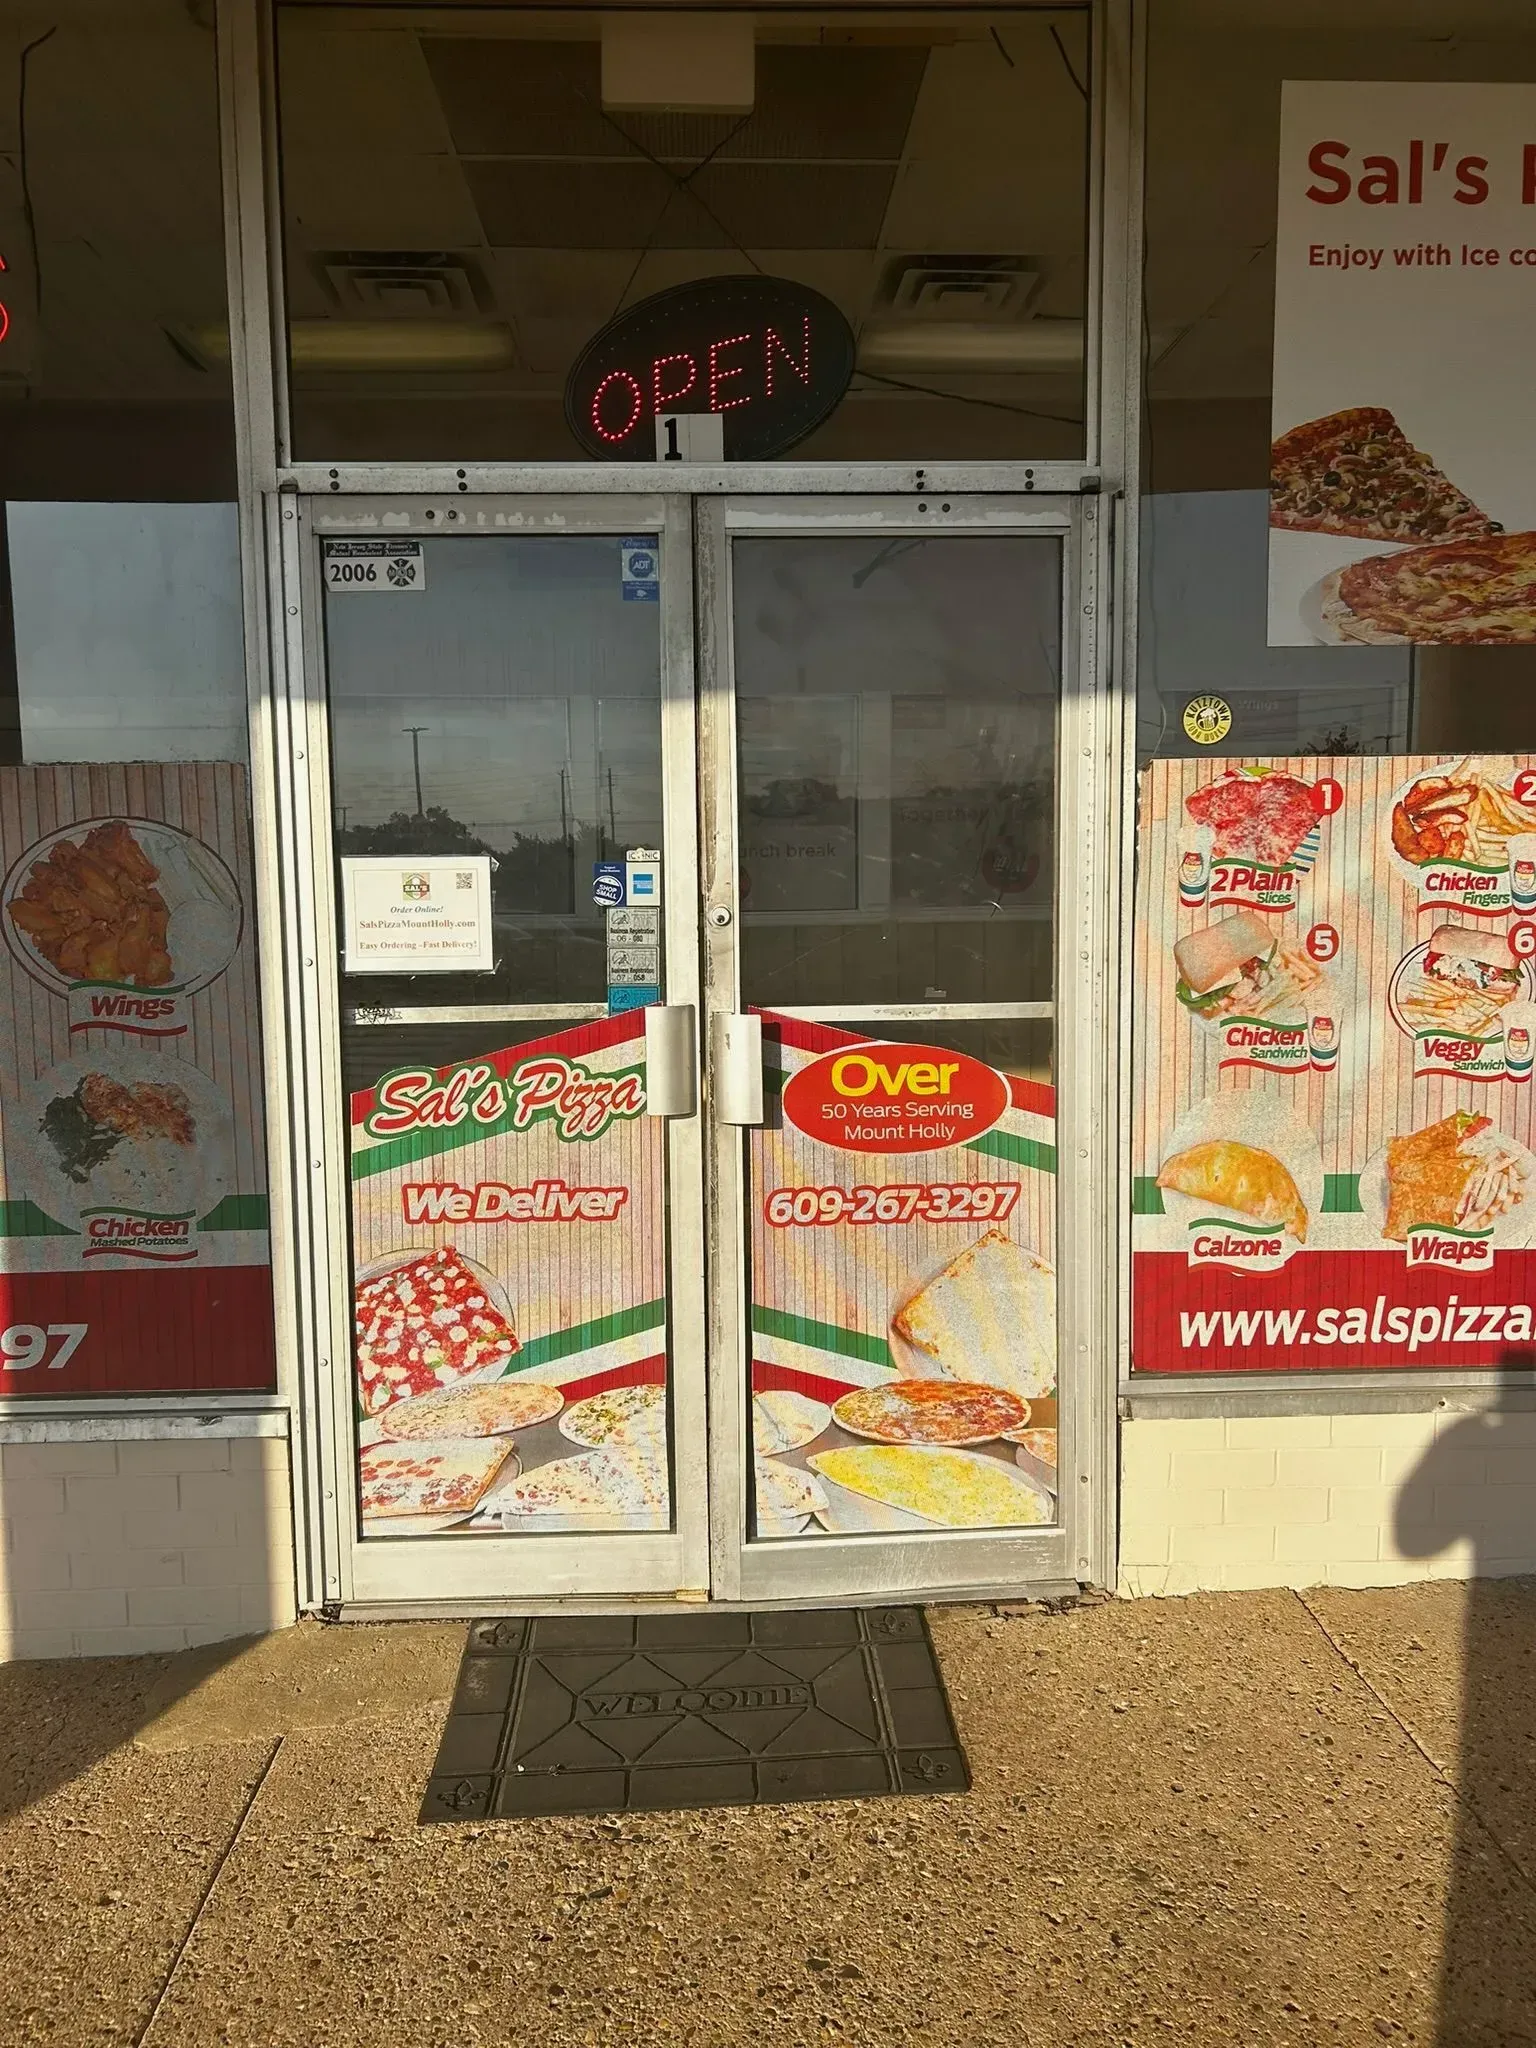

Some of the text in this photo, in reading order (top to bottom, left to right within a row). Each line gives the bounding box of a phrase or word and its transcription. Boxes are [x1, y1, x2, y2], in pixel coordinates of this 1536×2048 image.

[1305, 140, 1489, 205] Sal's
[1309, 244, 1384, 270] Enjoy
[1394, 244, 1451, 266] with
[1462, 245, 1500, 266] Ice
[592, 316, 809, 441] OPEN
[664, 418, 682, 461] 1
[330, 563, 377, 582] 2006
[633, 560, 650, 570] ADT
[1186, 697, 1230, 721] KUTZTOWN
[1321, 784, 1332, 810] 1
[599, 884, 618, 893] SHOP
[1210, 867, 1294, 892] 2 Plain
[1425, 872, 1498, 891] Chicken
[596, 888, 617, 900] SMALL
[1257, 892, 1292, 904] Slices
[1462, 892, 1510, 907] Fingers
[390, 905, 444, 914] Order Online!
[359, 919, 476, 930] SalsPizzaMountHolly.com
[360, 942, 378, 951] Easy
[380, 941, 417, 951] Ordering
[442, 940, 477, 949] Delivery!
[1313, 930, 1334, 957] 5
[1514, 927, 1535, 954] 6
[91, 995, 176, 1020] Wings
[1226, 1026, 1305, 1046] Chicken
[1249, 1046, 1308, 1059] Sandwich
[1423, 1039, 1486, 1062] Veggy
[831, 1054, 960, 1097] Over
[1453, 1060, 1505, 1071] Sandwich
[371, 1060, 646, 1137] Sal's Pizza
[821, 1102, 974, 1120] 50 Years Serving
[844, 1123, 956, 1140] Mount Holly
[405, 1183, 625, 1221] We Deliver
[768, 1186, 1018, 1223] 609-267-3297
[89, 1218, 189, 1237] Chicken
[90, 1237, 189, 1247] Mashed Potatoes
[1194, 1235, 1282, 1257] Calzone
[1411, 1236, 1488, 1264] Wraps
